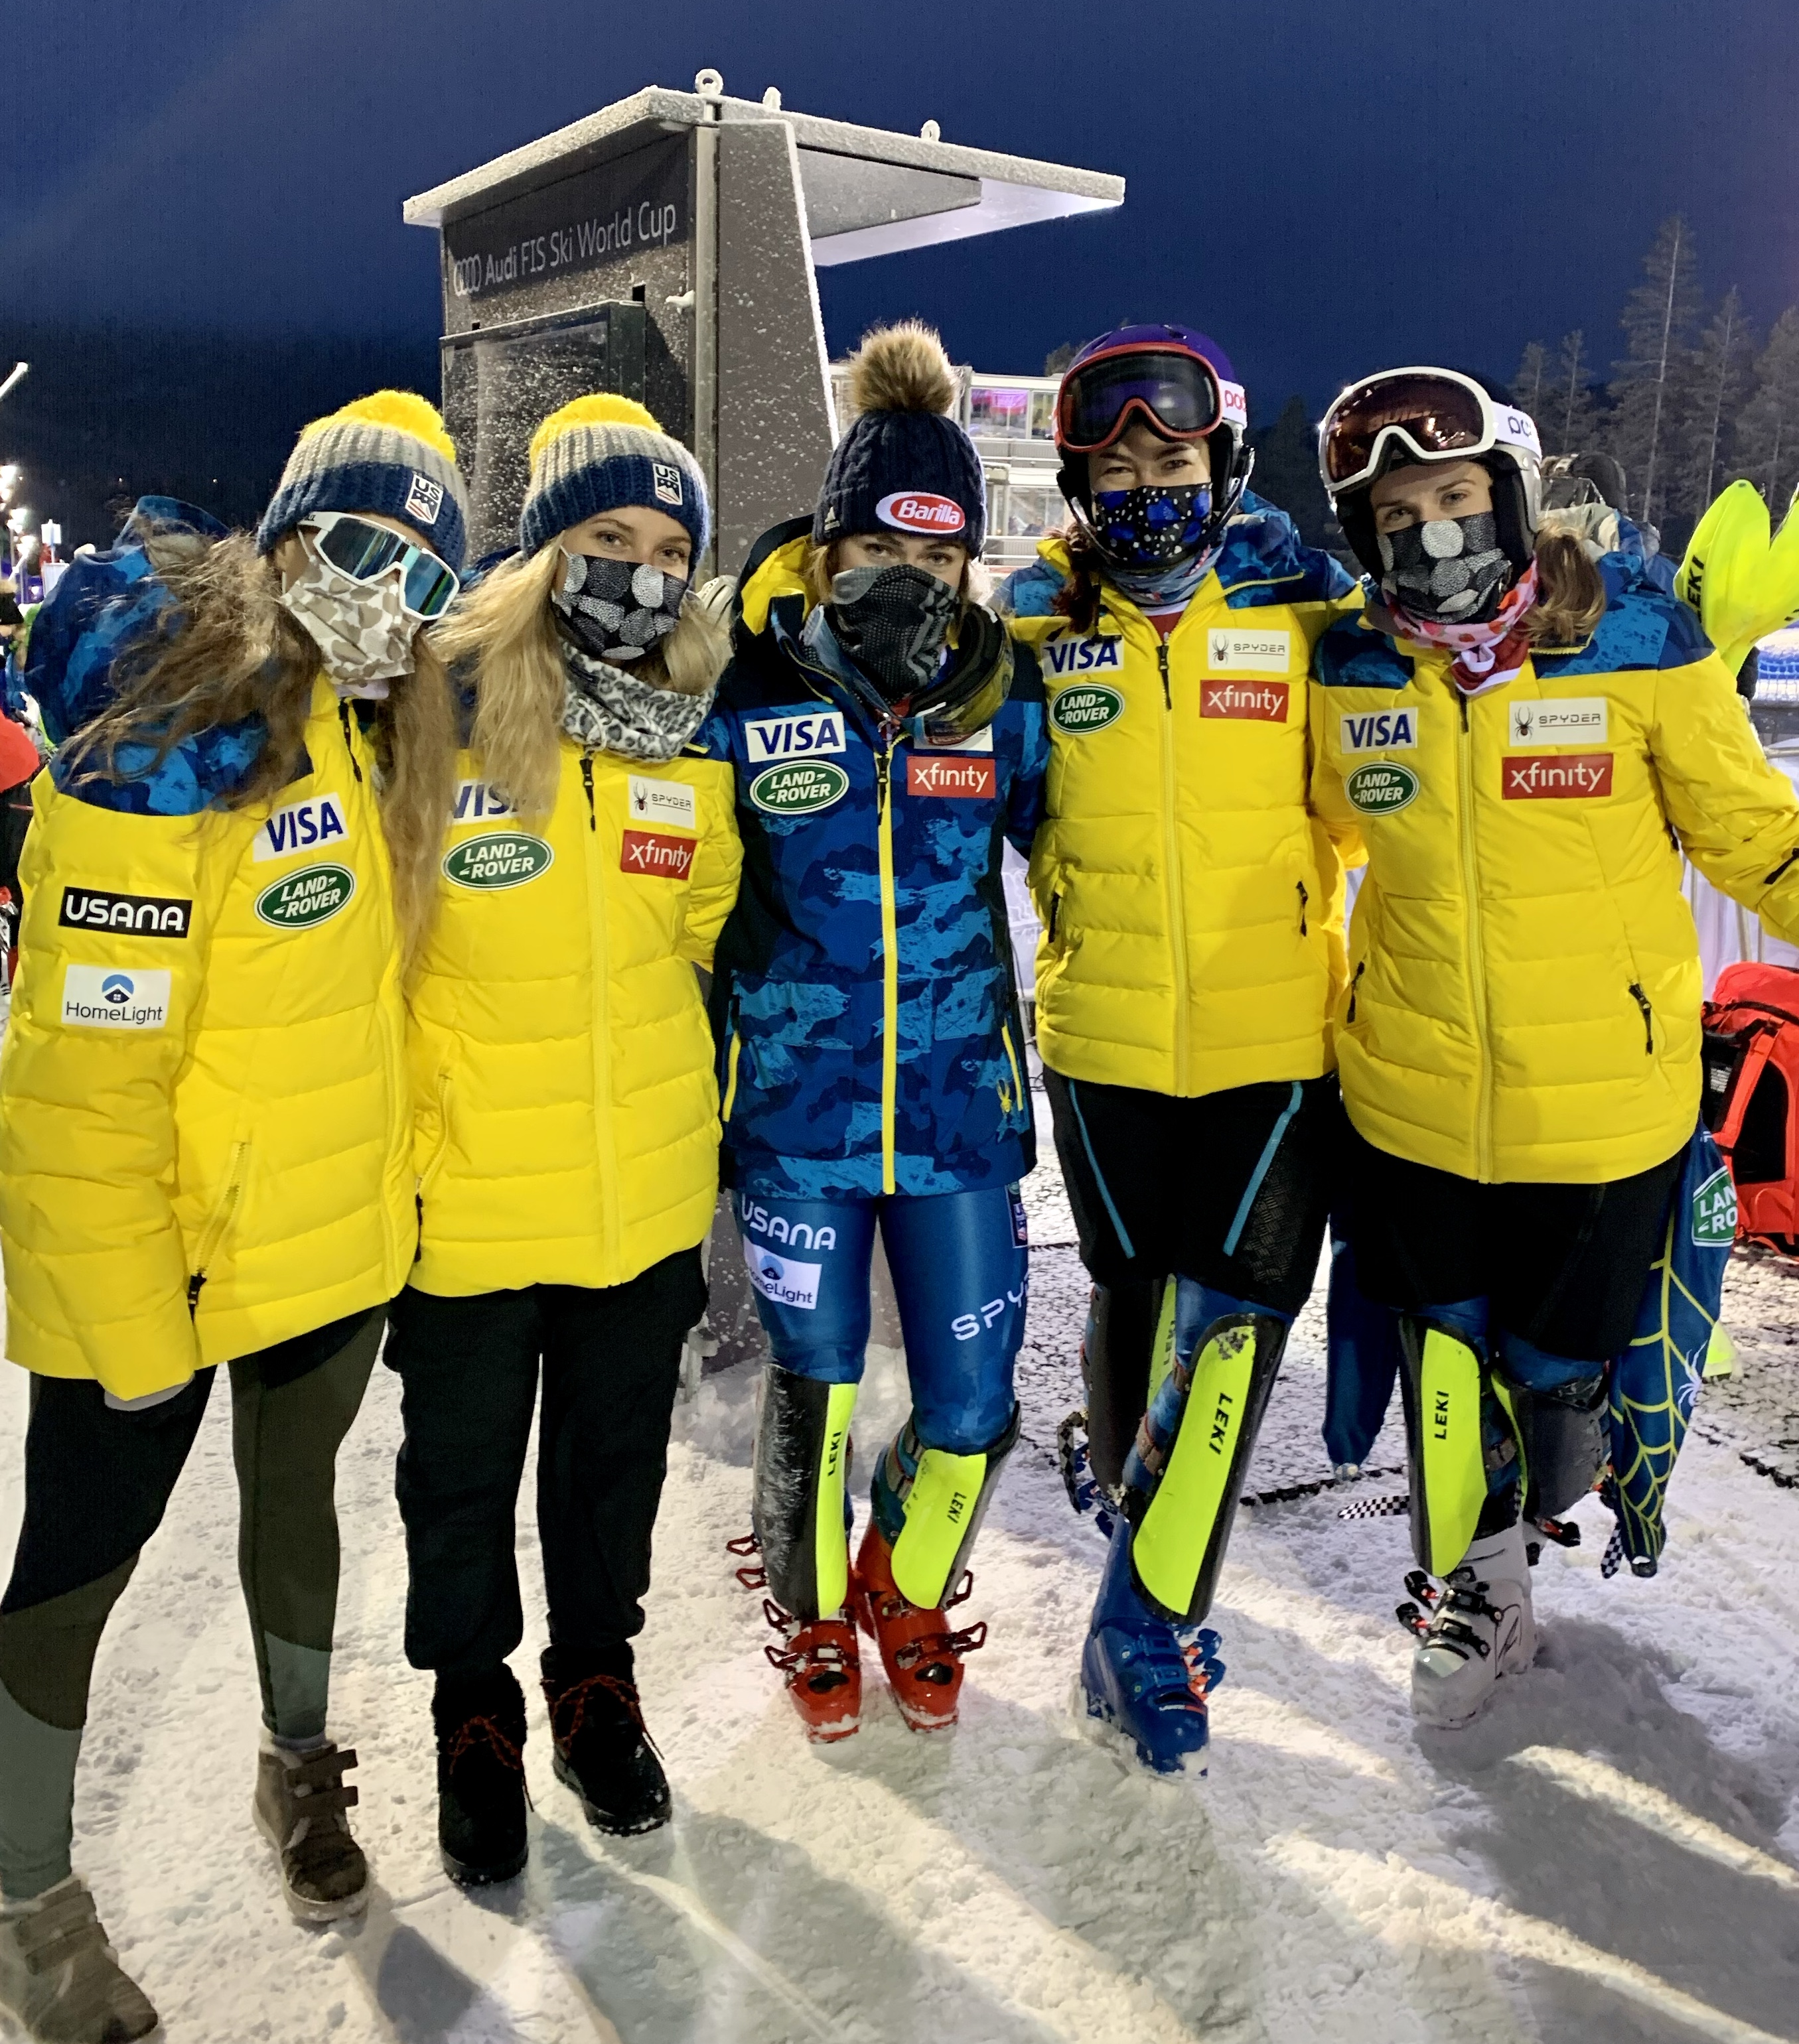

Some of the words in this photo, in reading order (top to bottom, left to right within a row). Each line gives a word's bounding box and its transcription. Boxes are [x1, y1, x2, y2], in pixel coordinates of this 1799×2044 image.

[486, 247, 517, 286] Audi
[522, 241, 545, 276] FIS
[550, 226, 573, 267] Ski
[577, 206, 631, 257] World
[638, 202, 676, 245] Cup
[415, 478, 439, 501] US
[656, 466, 678, 483] US
[897, 500, 961, 525] Barilla
[1044, 641, 1118, 673] VISA
[1233, 643, 1286, 653] SPYDER
[1207, 685, 1284, 716] xfinity
[1342, 713, 1412, 748] VISA
[1539, 713, 1601, 724] SPYDER
[751, 718, 840, 754] VISA
[914, 762, 989, 793] xfinity
[1510, 762, 1605, 793] xfinity
[453, 784, 518, 819] VIS
[651, 793, 692, 809] SPYDER
[265, 801, 344, 852] VISA
[629, 839, 691, 873] xfinity
[66, 894, 184, 931] USANA
[66, 1001, 163, 1024] HomeLight
[1699, 1182, 1738, 1218] LAN
[741, 1193, 836, 1251] USANA
[951, 1270, 1028, 1341] SPY
[1209, 1391, 1234, 1455] LEKI
[1434, 1391, 1449, 1440] LEKI
[827, 1431, 841, 1477] LEKI
[947, 1491, 968, 1524] LEKI
